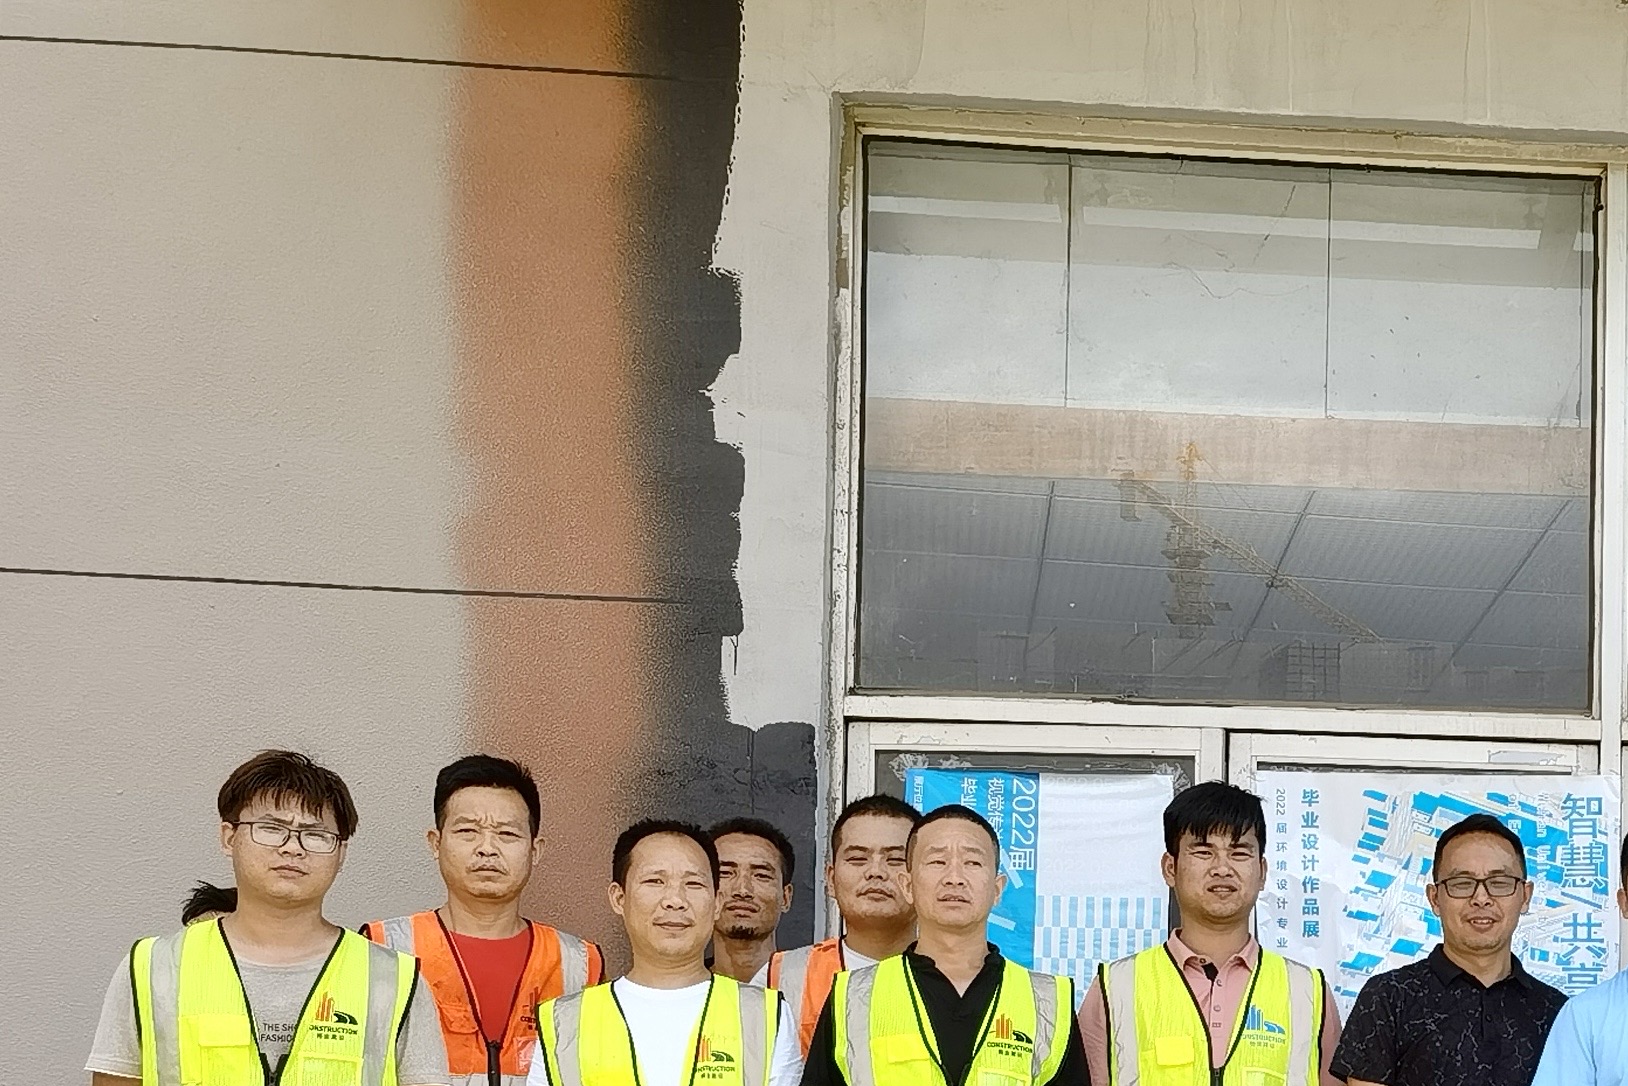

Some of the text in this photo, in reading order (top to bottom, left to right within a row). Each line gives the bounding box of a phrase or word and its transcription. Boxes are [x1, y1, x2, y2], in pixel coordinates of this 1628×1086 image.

[1009, 778, 1037, 871] 2022届
[1301, 788, 1320, 938] 毕业设计作品展
[262, 1022, 280, 1032] THE
